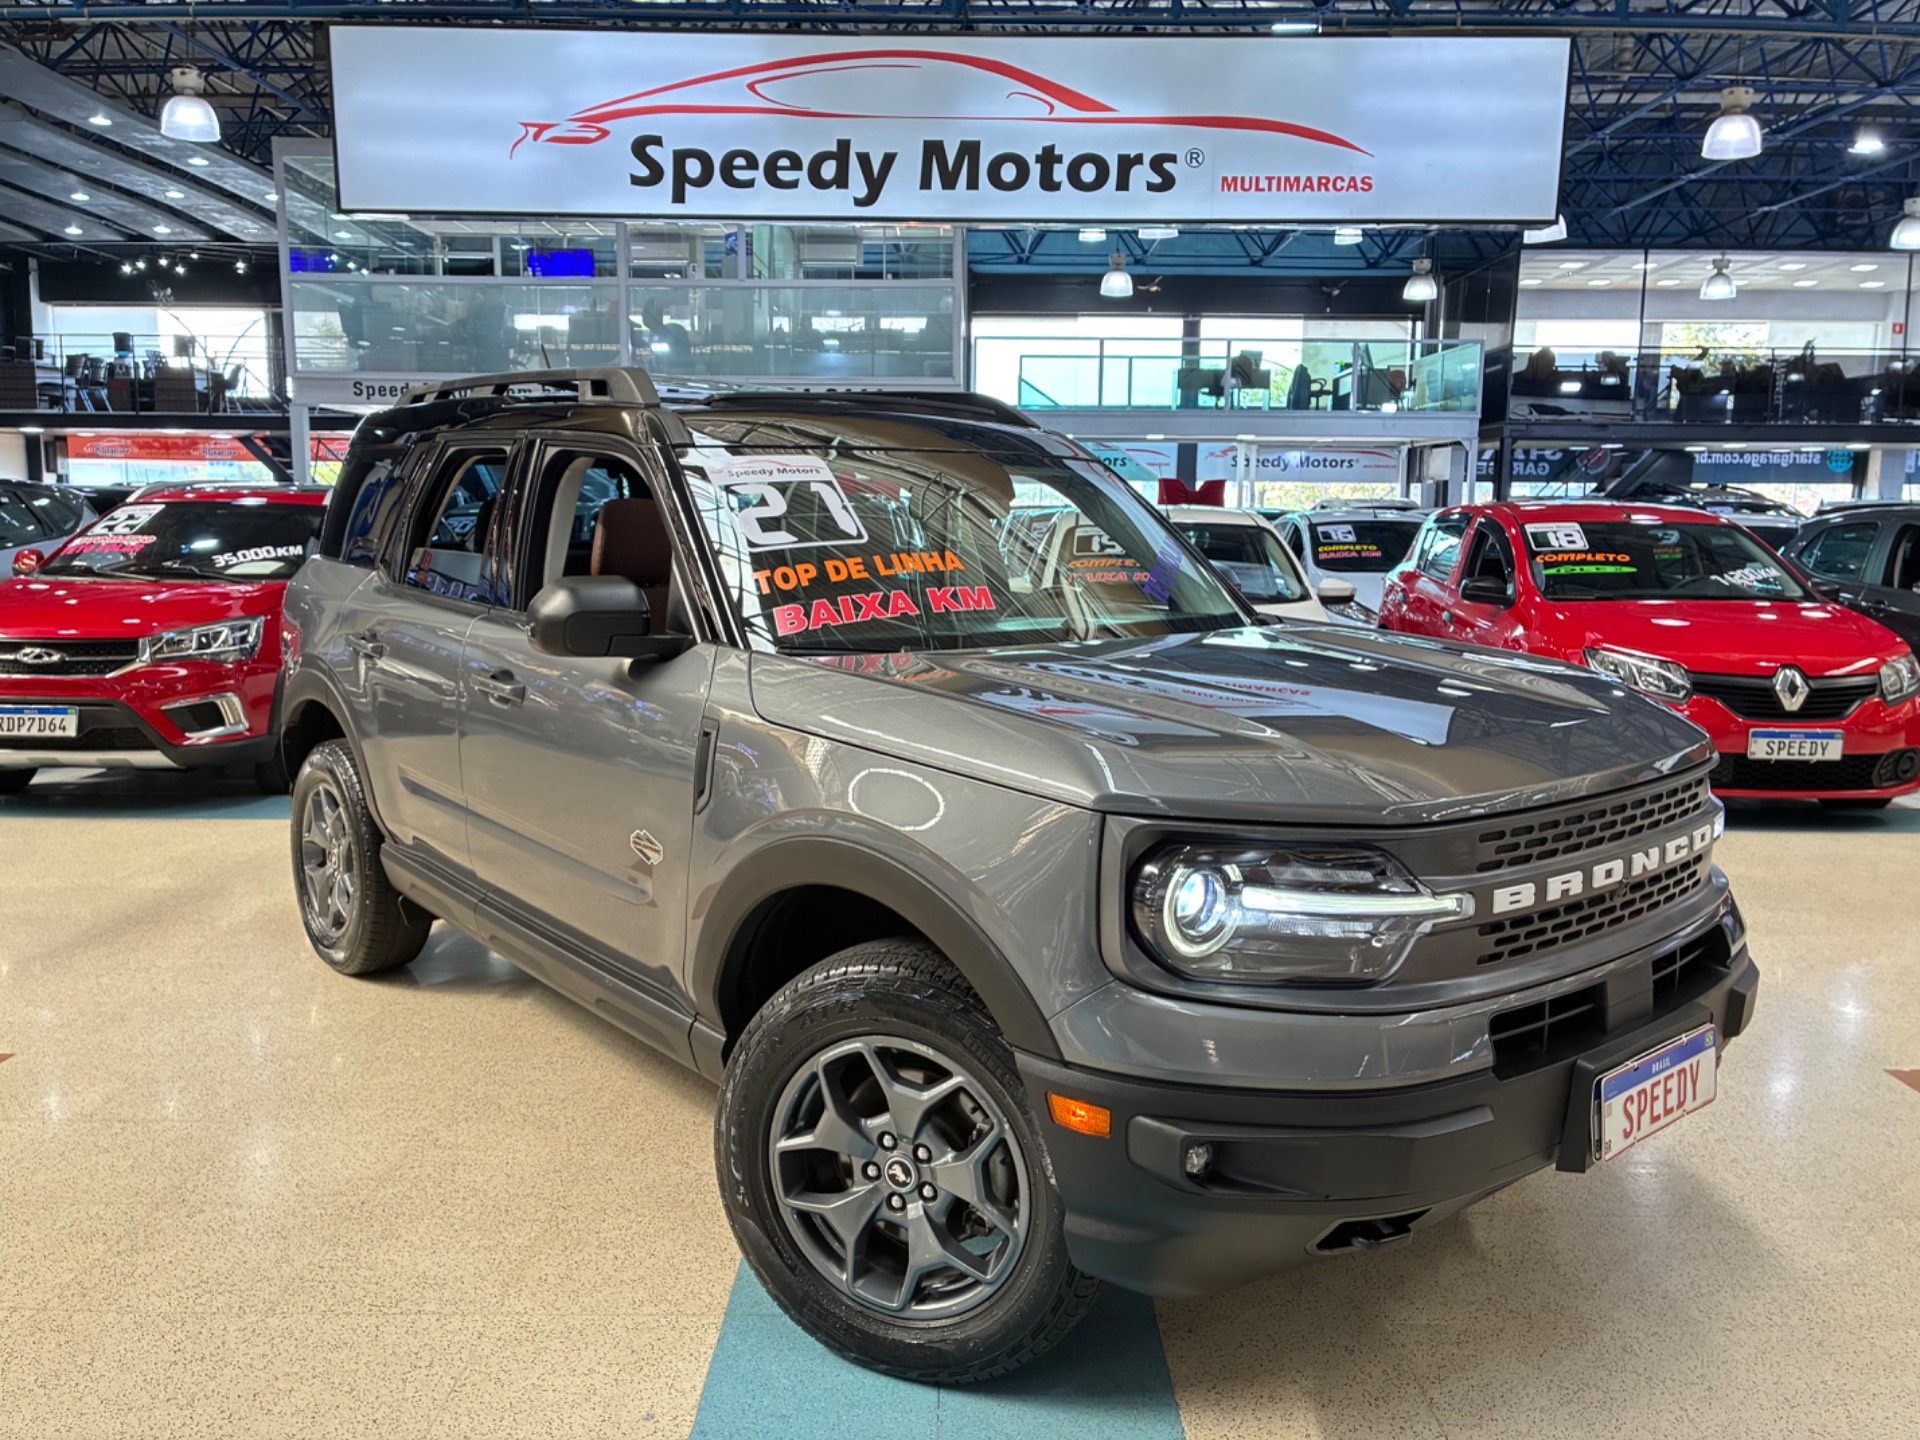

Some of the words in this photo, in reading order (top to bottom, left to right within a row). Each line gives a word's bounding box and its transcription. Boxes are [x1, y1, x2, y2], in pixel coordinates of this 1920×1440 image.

[629, 134, 898, 207] Speedy
[1220, 174, 1374, 193] MULTIMARCAS
[353, 381, 409, 398] Speed
[727, 468, 774, 478] Speedy
[777, 466, 821, 475] Motors
[91, 510, 147, 534] 22
[729, 481, 858, 545] 21
[1547, 530, 1586, 548] 18
[1535, 553, 1631, 563] COMPLETO
[752, 563, 818, 596] TOP
[824, 557, 870, 583] DE
[873, 551, 966, 577] LINHA
[773, 589, 921, 637] BAIXA
[926, 586, 996, 613] KM
[1765, 740, 1830, 757] SPEEDY
[1492, 824, 1712, 915] BRONCO
[1651, 1056, 1671, 1074] BRASIL
[1623, 1058, 1701, 1140] SPEEDY
